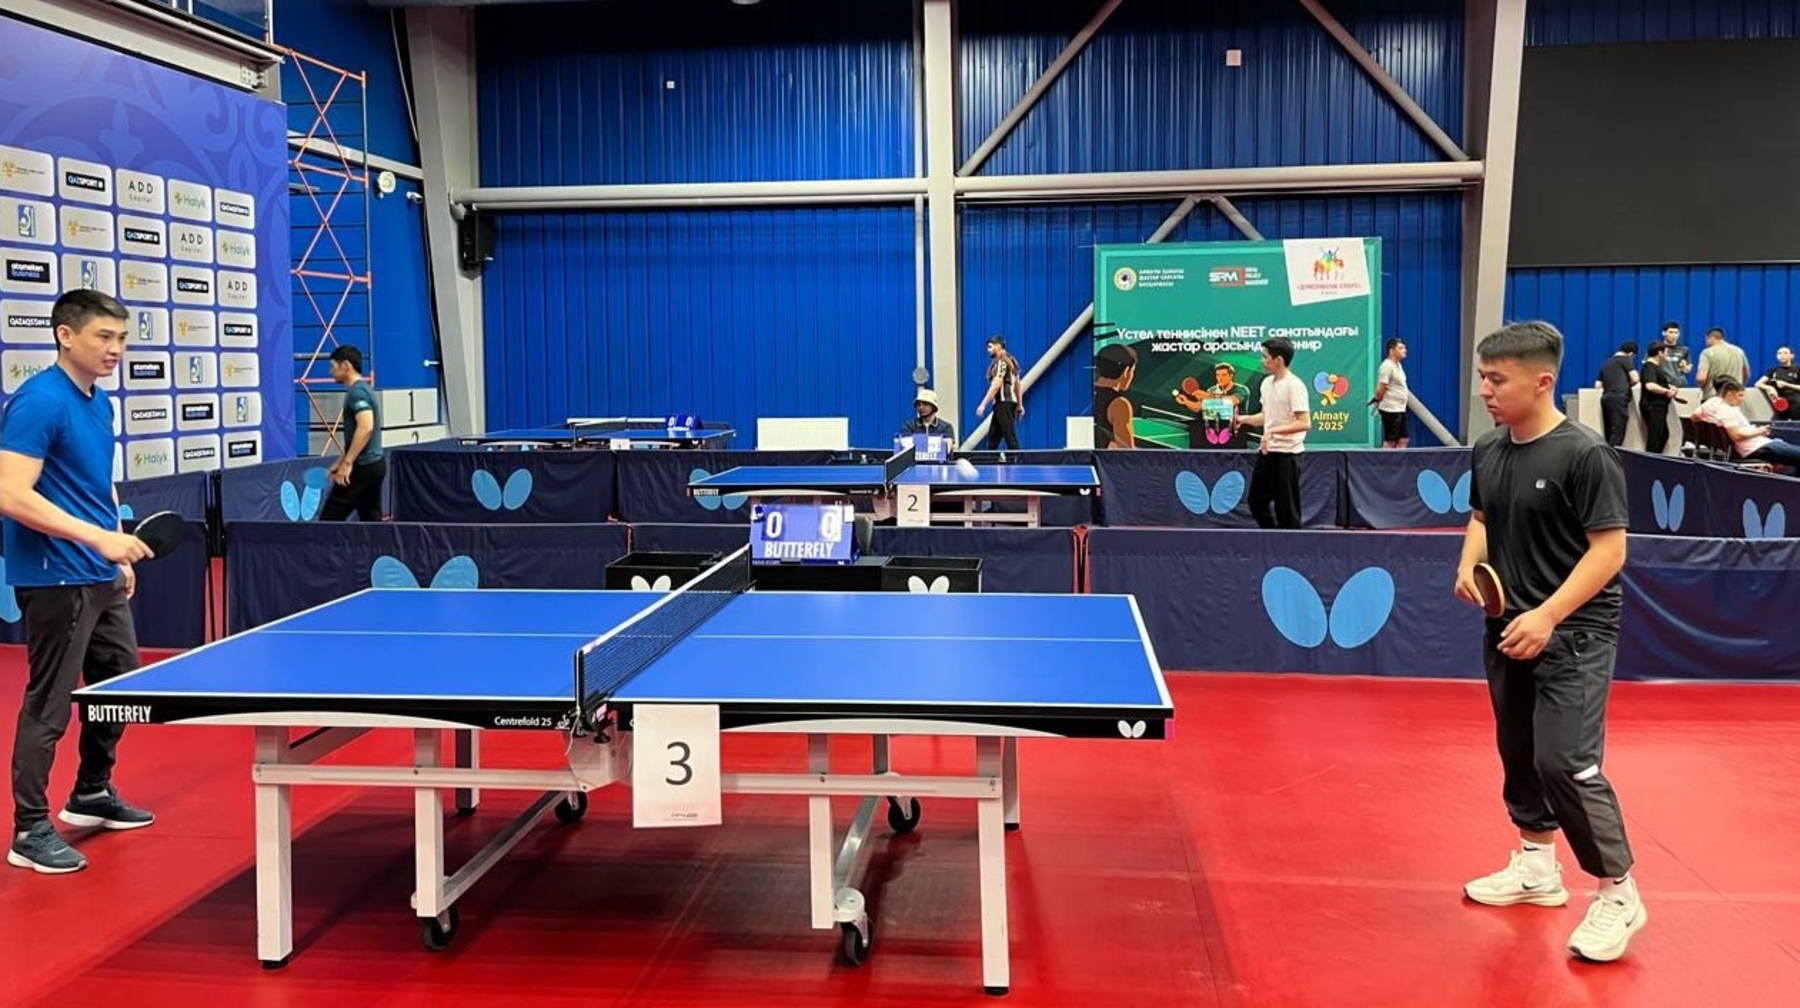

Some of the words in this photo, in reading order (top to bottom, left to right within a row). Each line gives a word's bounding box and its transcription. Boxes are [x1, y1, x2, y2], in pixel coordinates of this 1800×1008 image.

[129, 180, 154, 194] ADD
[184, 194, 207, 209] Halyk
[181, 232, 203, 245] ADD
[231, 243, 250, 256] Halyk
[228, 281, 248, 292] ADD
[1116, 328, 1154, 340] Үстел
[1156, 327, 1229, 340] теннисінен
[1230, 326, 1266, 338] NEET
[1268, 326, 1359, 339] санатындағы
[1151, 341, 1201, 354] жастар
[1203, 340, 1263, 353] арасынд
[408, 391, 415, 422] 1
[1312, 411, 1350, 423] Almaty
[1318, 421, 1344, 431] 2025
[144, 452, 167, 465] Halyk
[907, 494, 919, 511] 2
[766, 511, 783, 539] 0
[821, 511, 839, 539] 0
[764, 541, 835, 558] BUTTERFLY
[88, 704, 152, 723] BUTTERFLY
[494, 716, 540, 727] Centrefold
[541, 717, 552, 727] 25
[665, 741, 693, 785] 3
